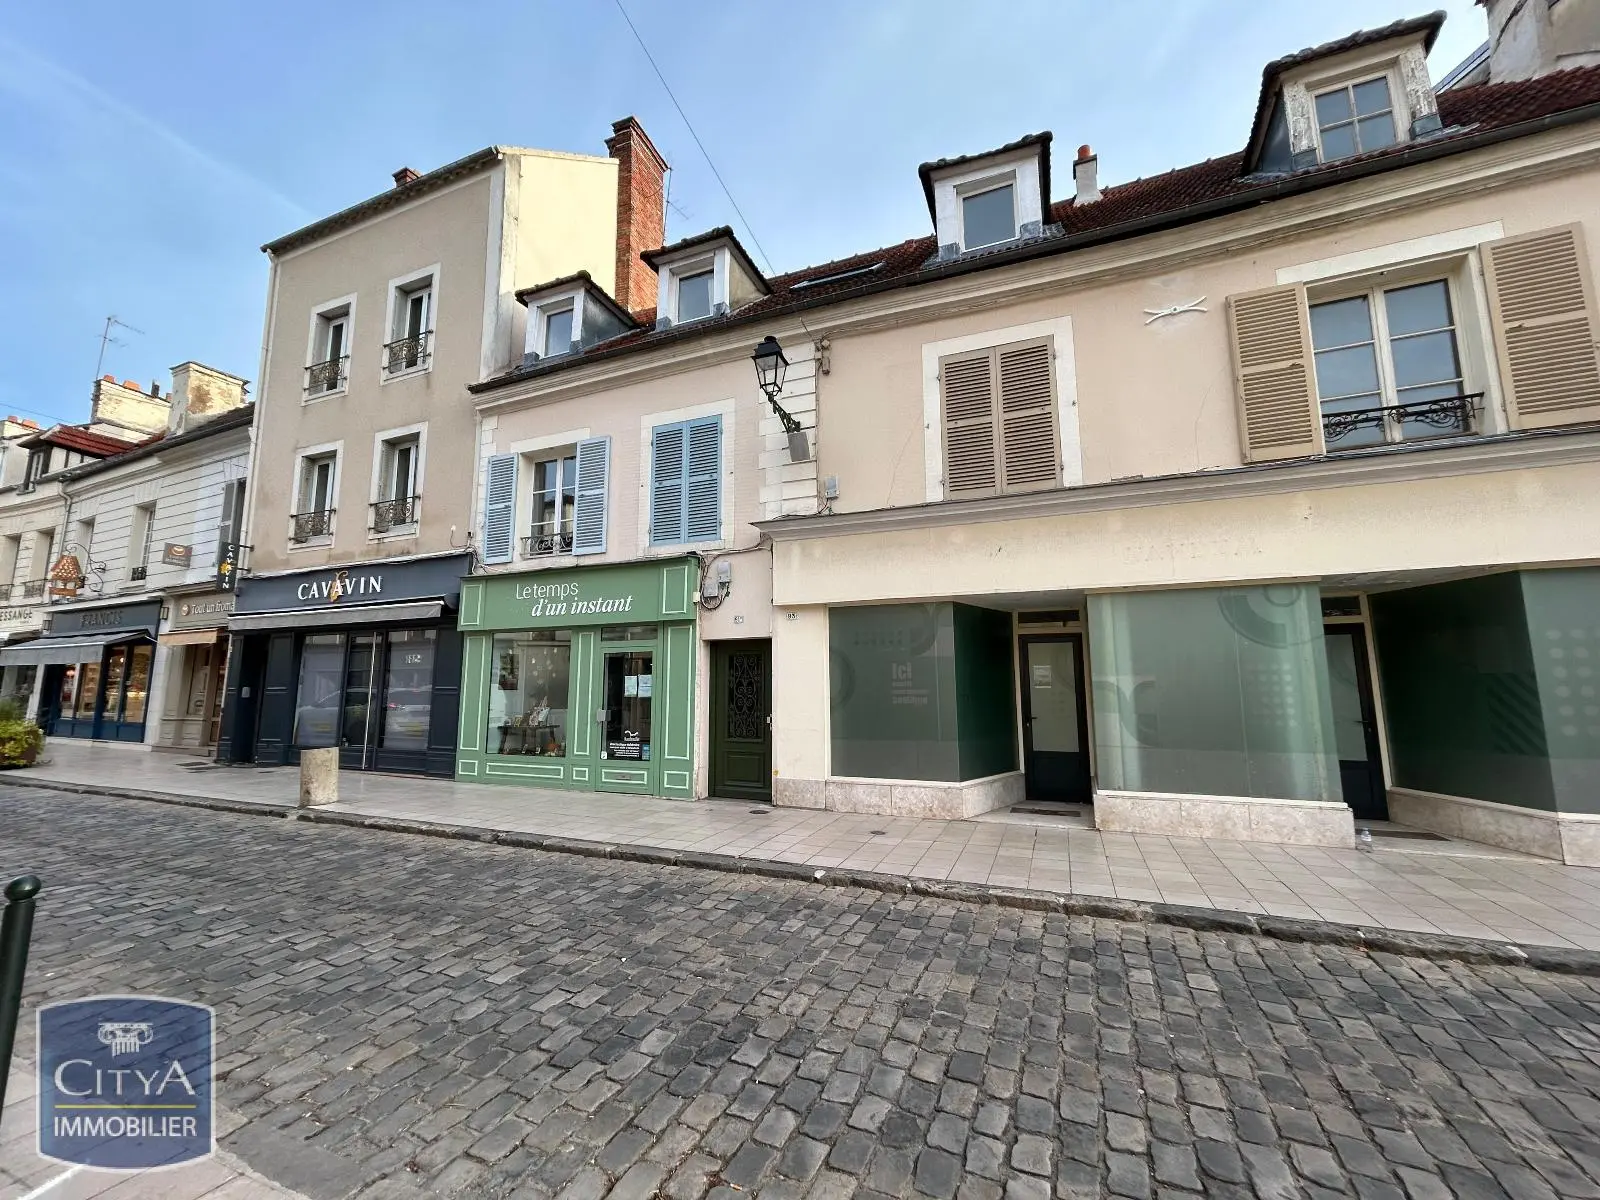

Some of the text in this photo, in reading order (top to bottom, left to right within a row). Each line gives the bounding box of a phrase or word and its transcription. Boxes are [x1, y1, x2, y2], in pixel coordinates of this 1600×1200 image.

[222, 544, 235, 589] CAVAVIN
[297, 575, 383, 600] CAVAVIN
[516, 582, 579, 602] Le temps
[531, 594, 633, 617] d'un instant
